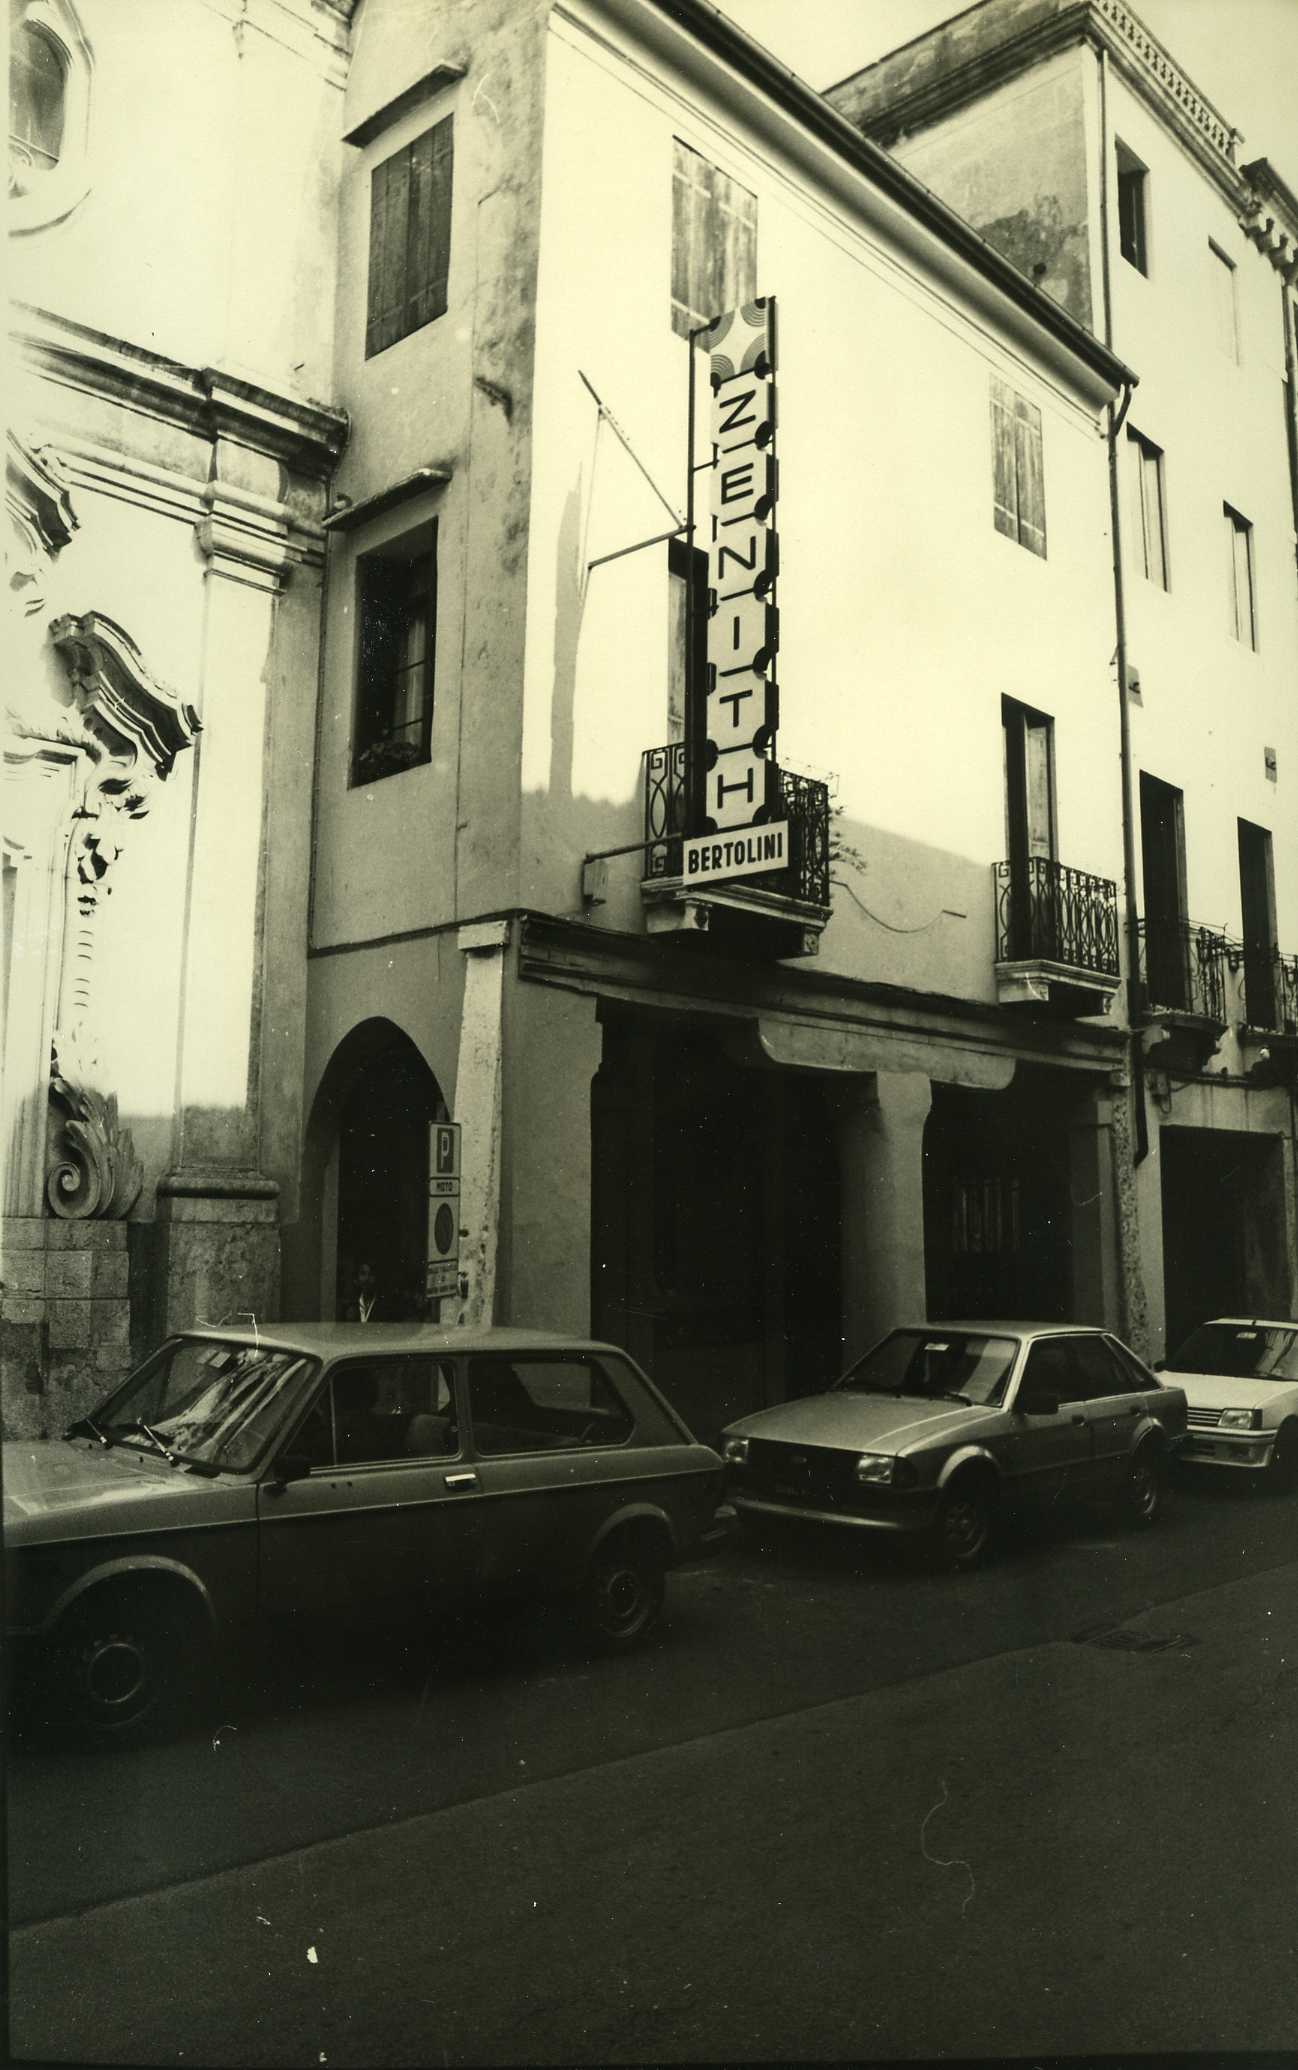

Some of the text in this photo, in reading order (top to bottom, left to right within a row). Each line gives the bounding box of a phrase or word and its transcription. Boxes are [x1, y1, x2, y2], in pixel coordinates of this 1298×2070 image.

[717, 389, 757, 810] ZENITH
[688, 832, 783, 874] BERTOLINI
[441, 1131, 450, 1169] P
